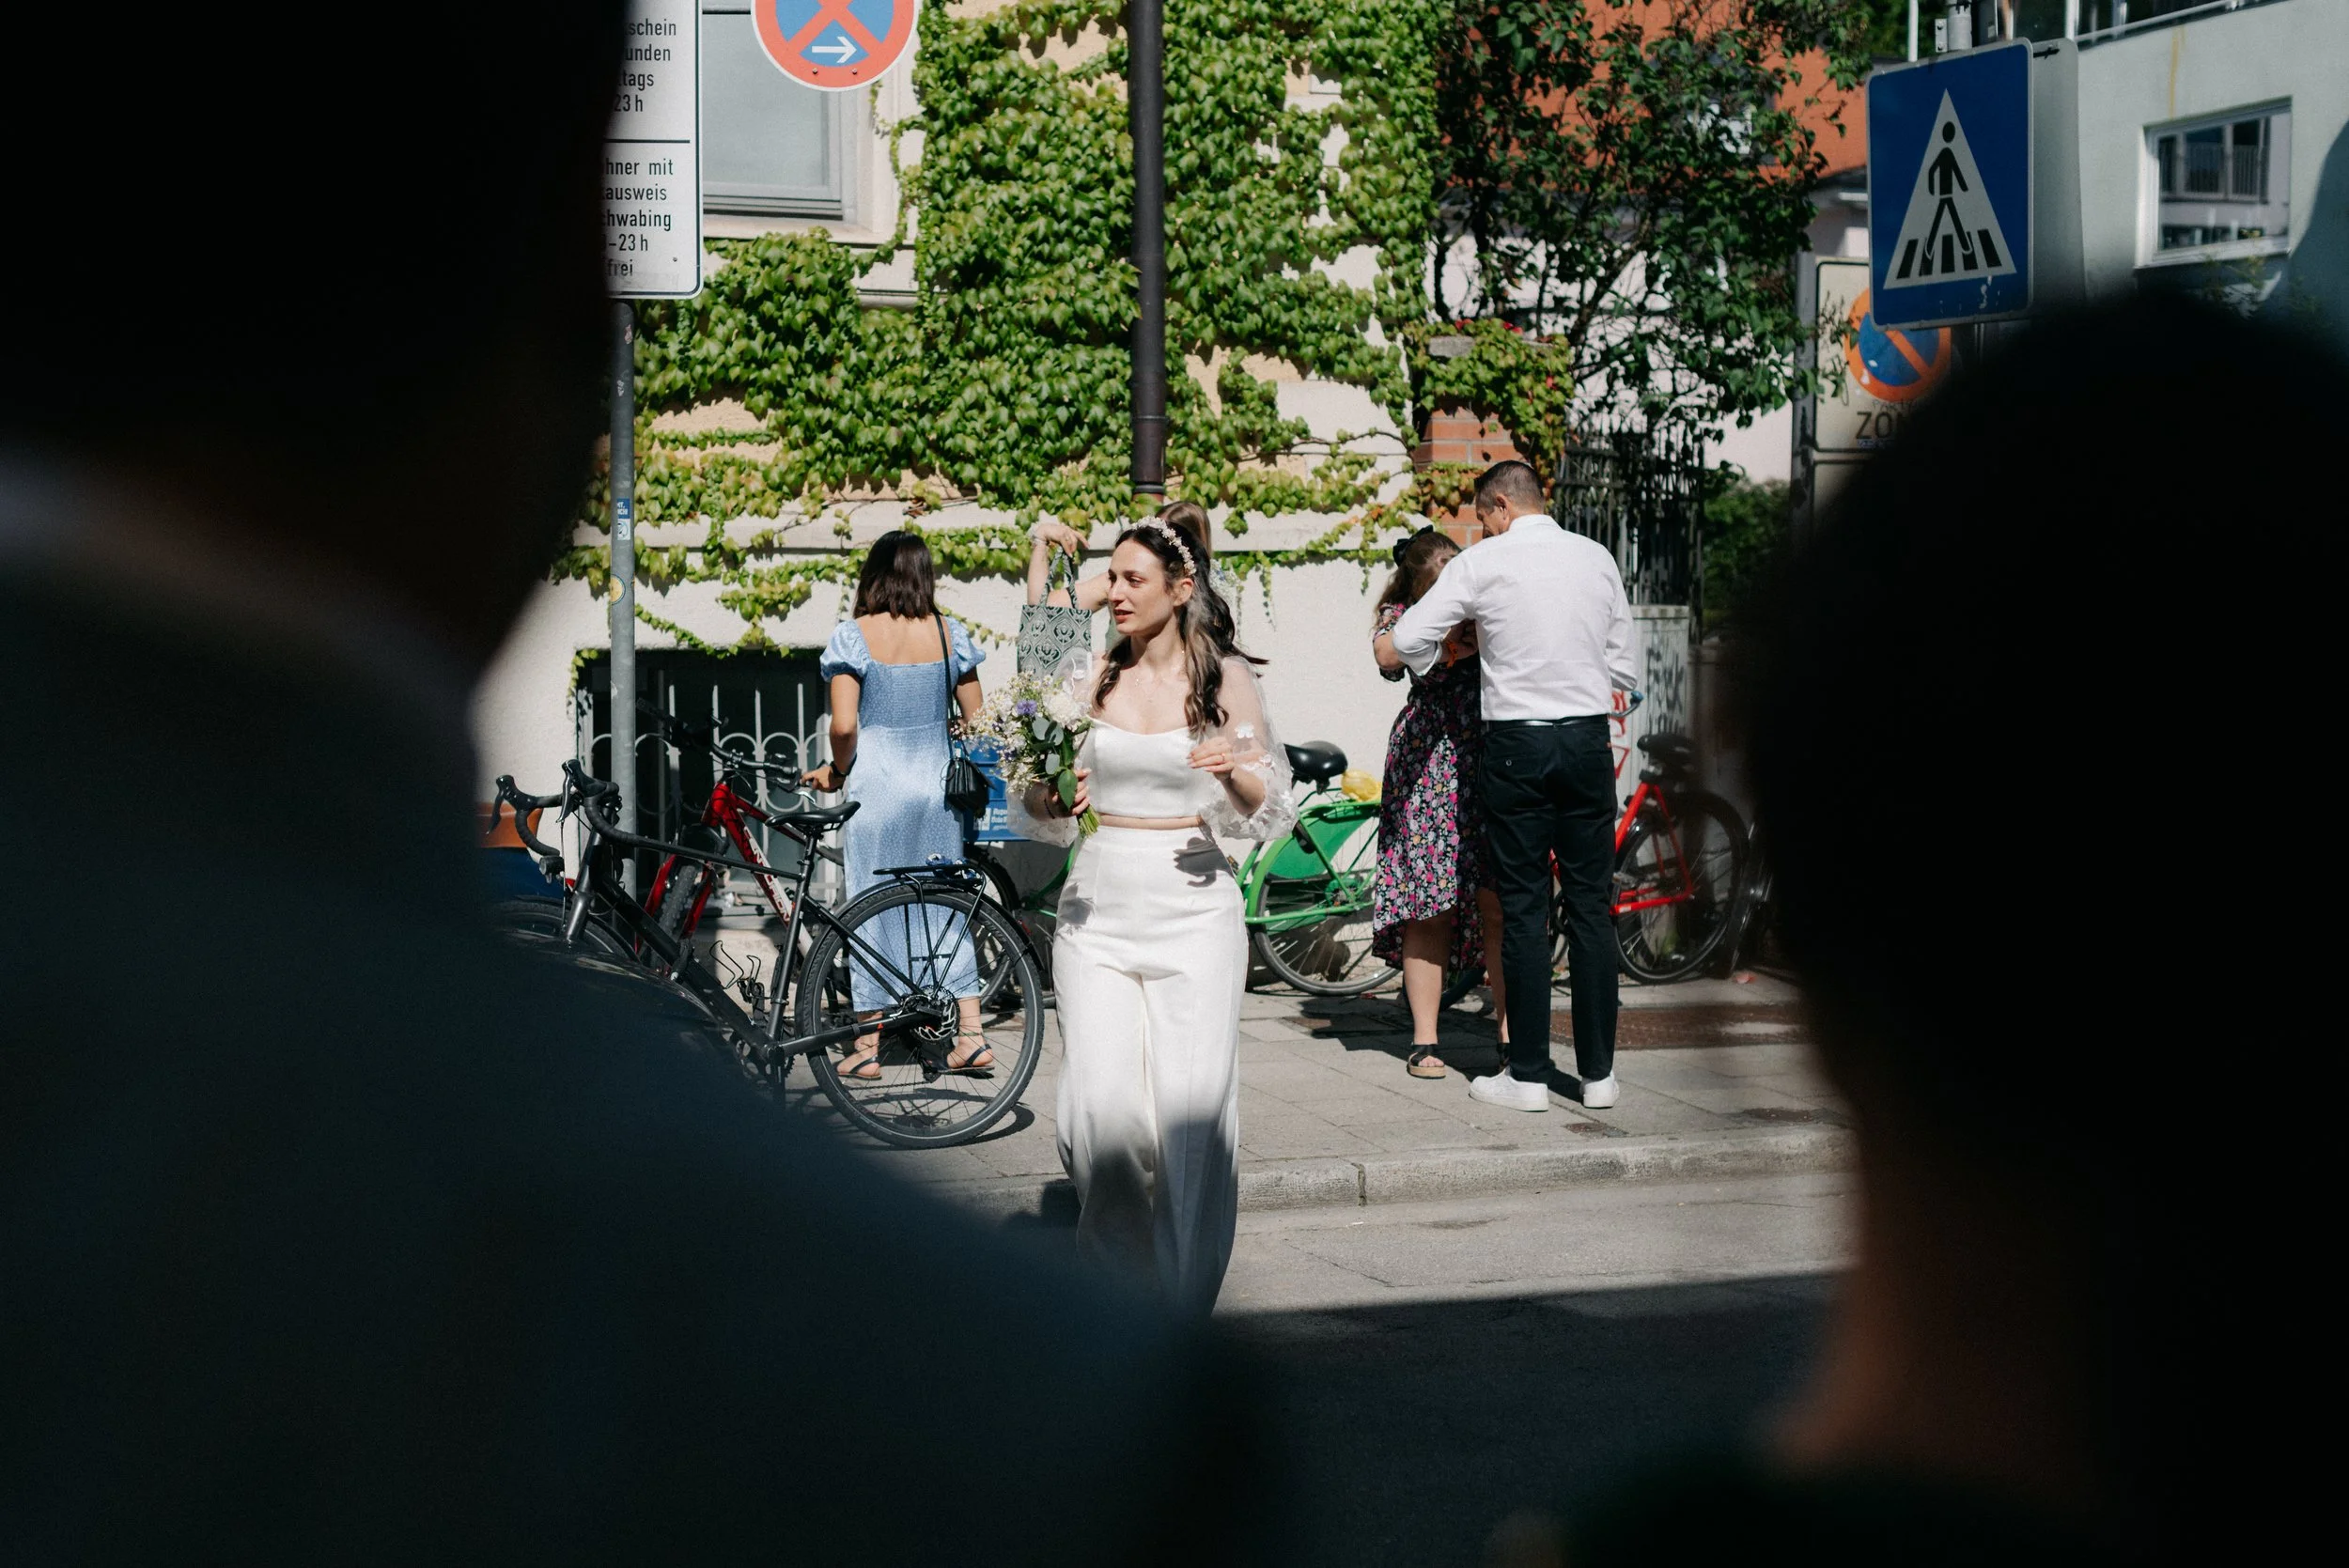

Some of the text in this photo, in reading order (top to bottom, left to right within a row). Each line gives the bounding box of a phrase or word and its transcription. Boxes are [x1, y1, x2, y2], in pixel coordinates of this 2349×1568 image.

[618, 70, 655, 91] tags
[635, 94, 644, 112] h
[649, 158, 674, 176] mit
[602, 183, 668, 201] ausweis
[640, 234, 648, 252] h
[607, 258, 633, 276] frei
[742, 825, 792, 922] CENURION
